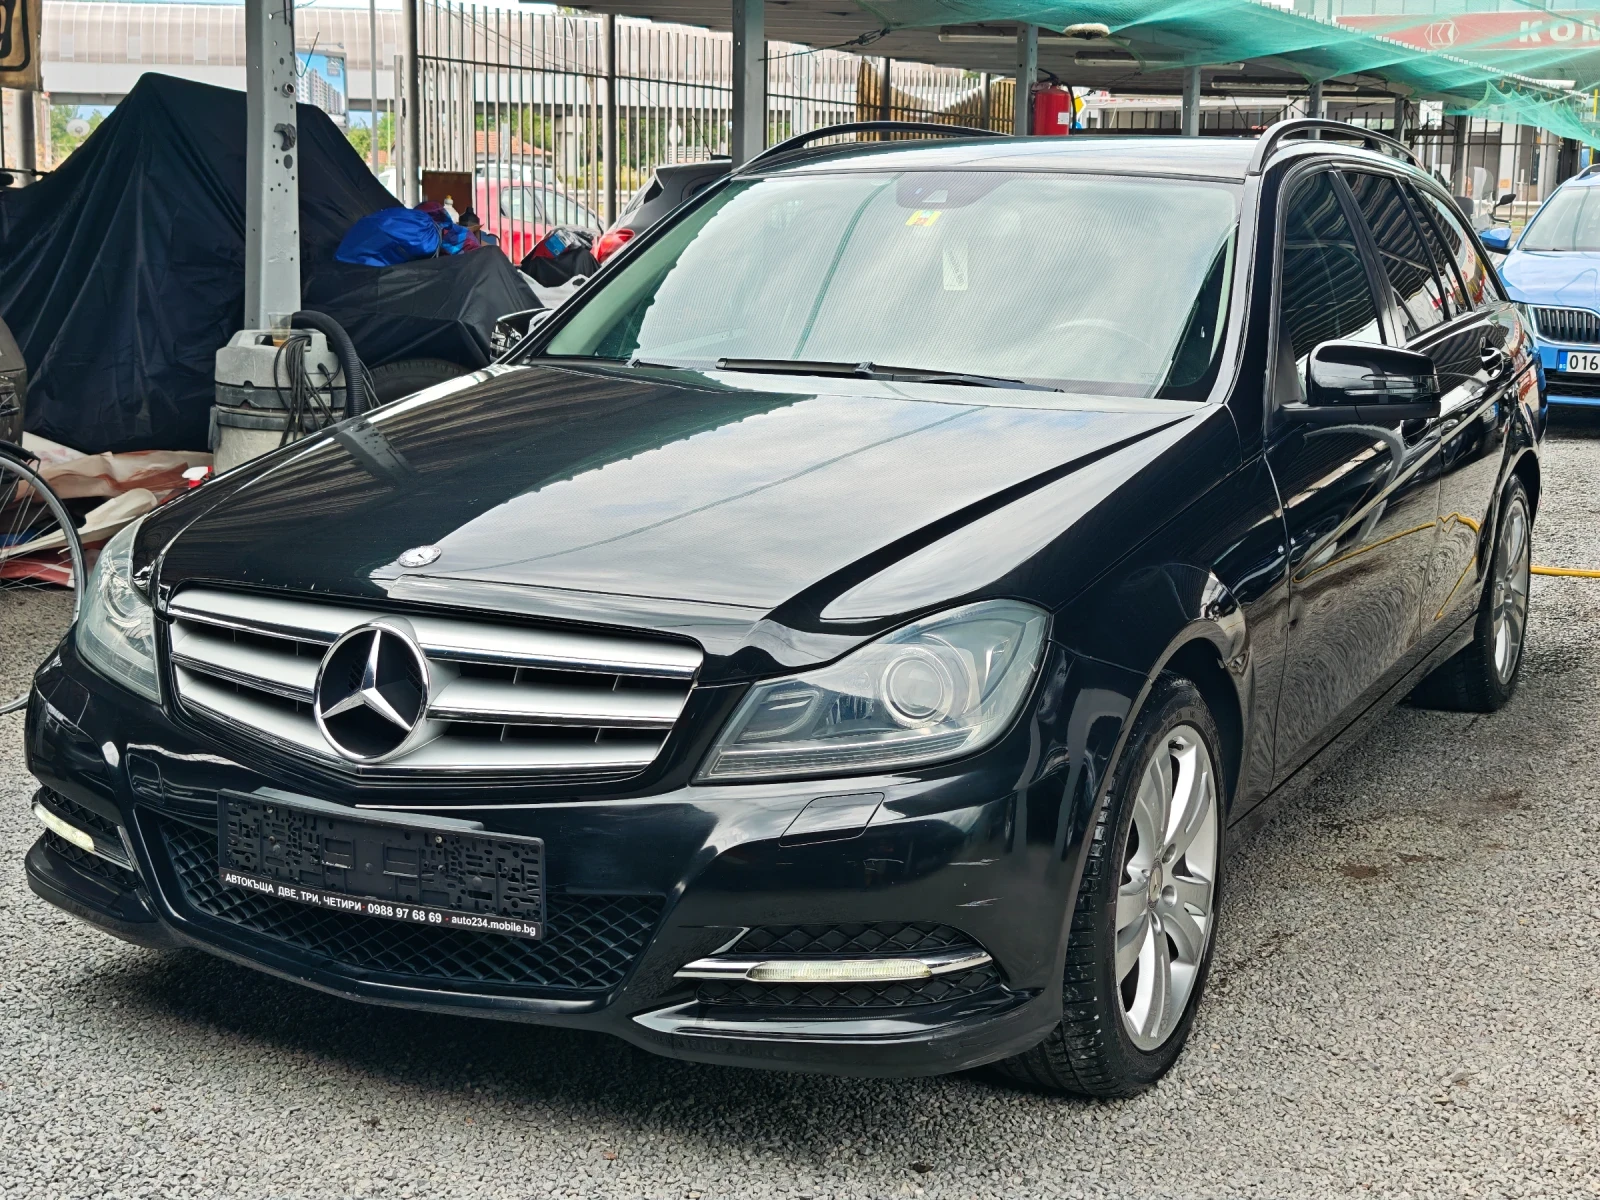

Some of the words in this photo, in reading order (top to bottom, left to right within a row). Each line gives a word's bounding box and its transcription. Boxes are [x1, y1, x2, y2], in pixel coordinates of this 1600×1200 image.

[225, 873, 275, 893] АВТОКЪЩА
[278, 886, 299, 900] ДВЕ,
[301, 891, 322, 905] ТРИ,
[323, 896, 362, 912] ЧЕТИРИ
[367, 903, 394, 917] 0988
[395, 907, 409, 919] 97
[412, 909, 426, 922] 68
[428, 912, 442, 924] 69
[451, 915, 536, 936] auto234.mobile.bg
